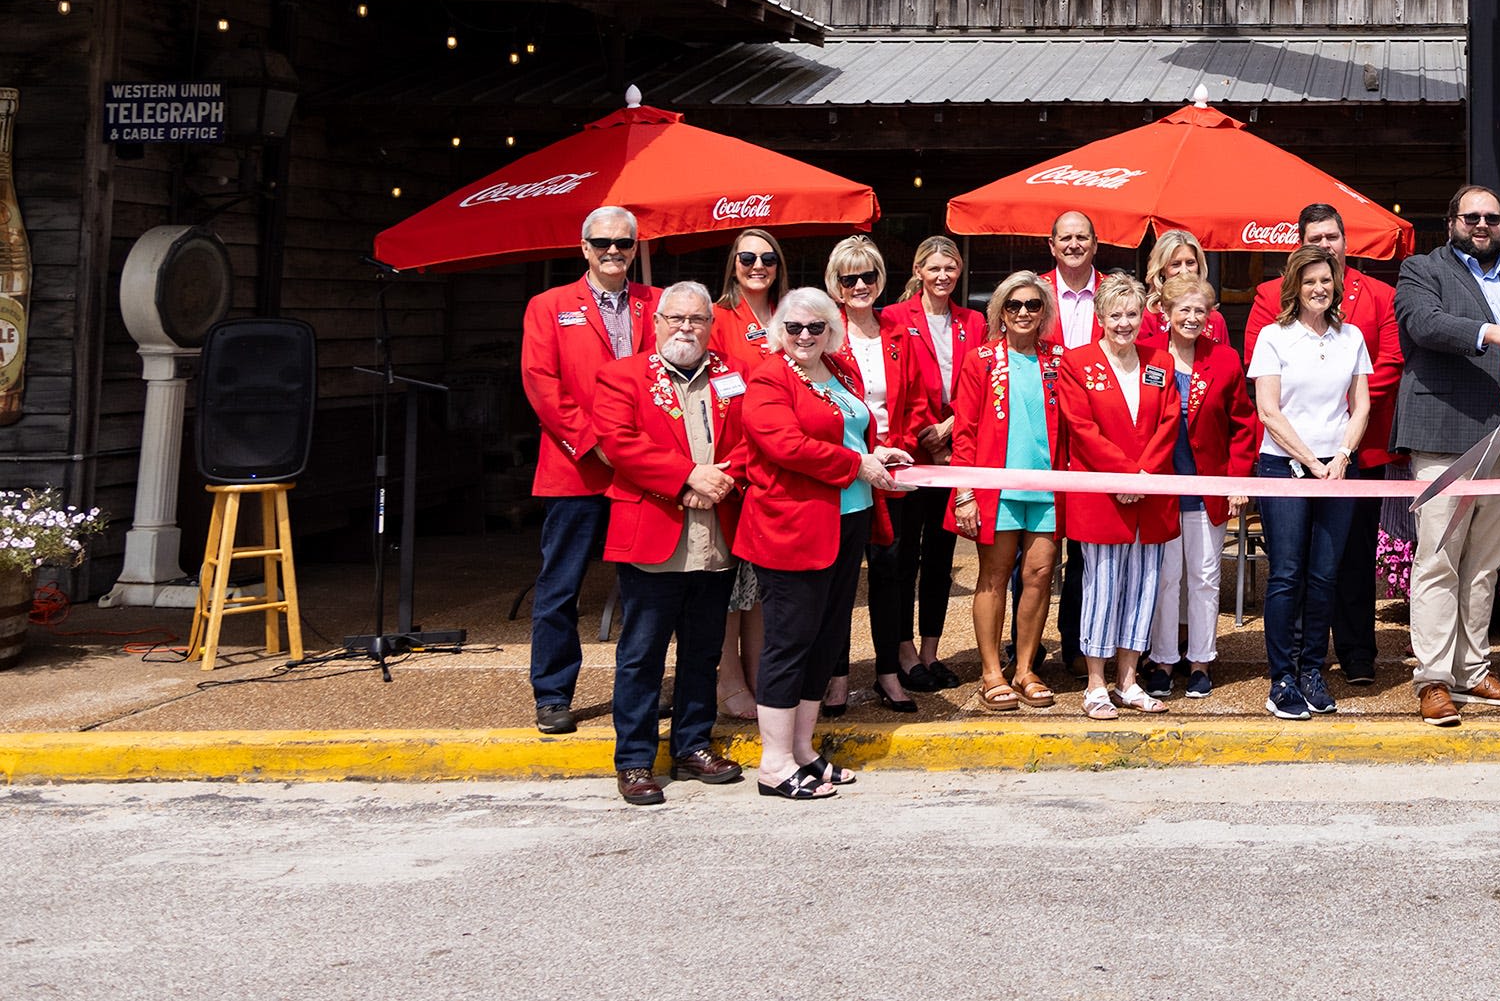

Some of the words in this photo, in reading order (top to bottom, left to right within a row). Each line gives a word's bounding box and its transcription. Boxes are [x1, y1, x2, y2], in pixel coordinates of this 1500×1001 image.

[112, 84, 177, 99] WESTERN
[180, 83, 221, 98] UNION
[105, 101, 224, 124] TELEGRAPH
[109, 129, 119, 141] &
[122, 127, 165, 140] CABLE
[170, 126, 218, 140] OFFICE
[459, 171, 600, 208] Coca-Cola
[713, 194, 775, 221] Coca-Cola
